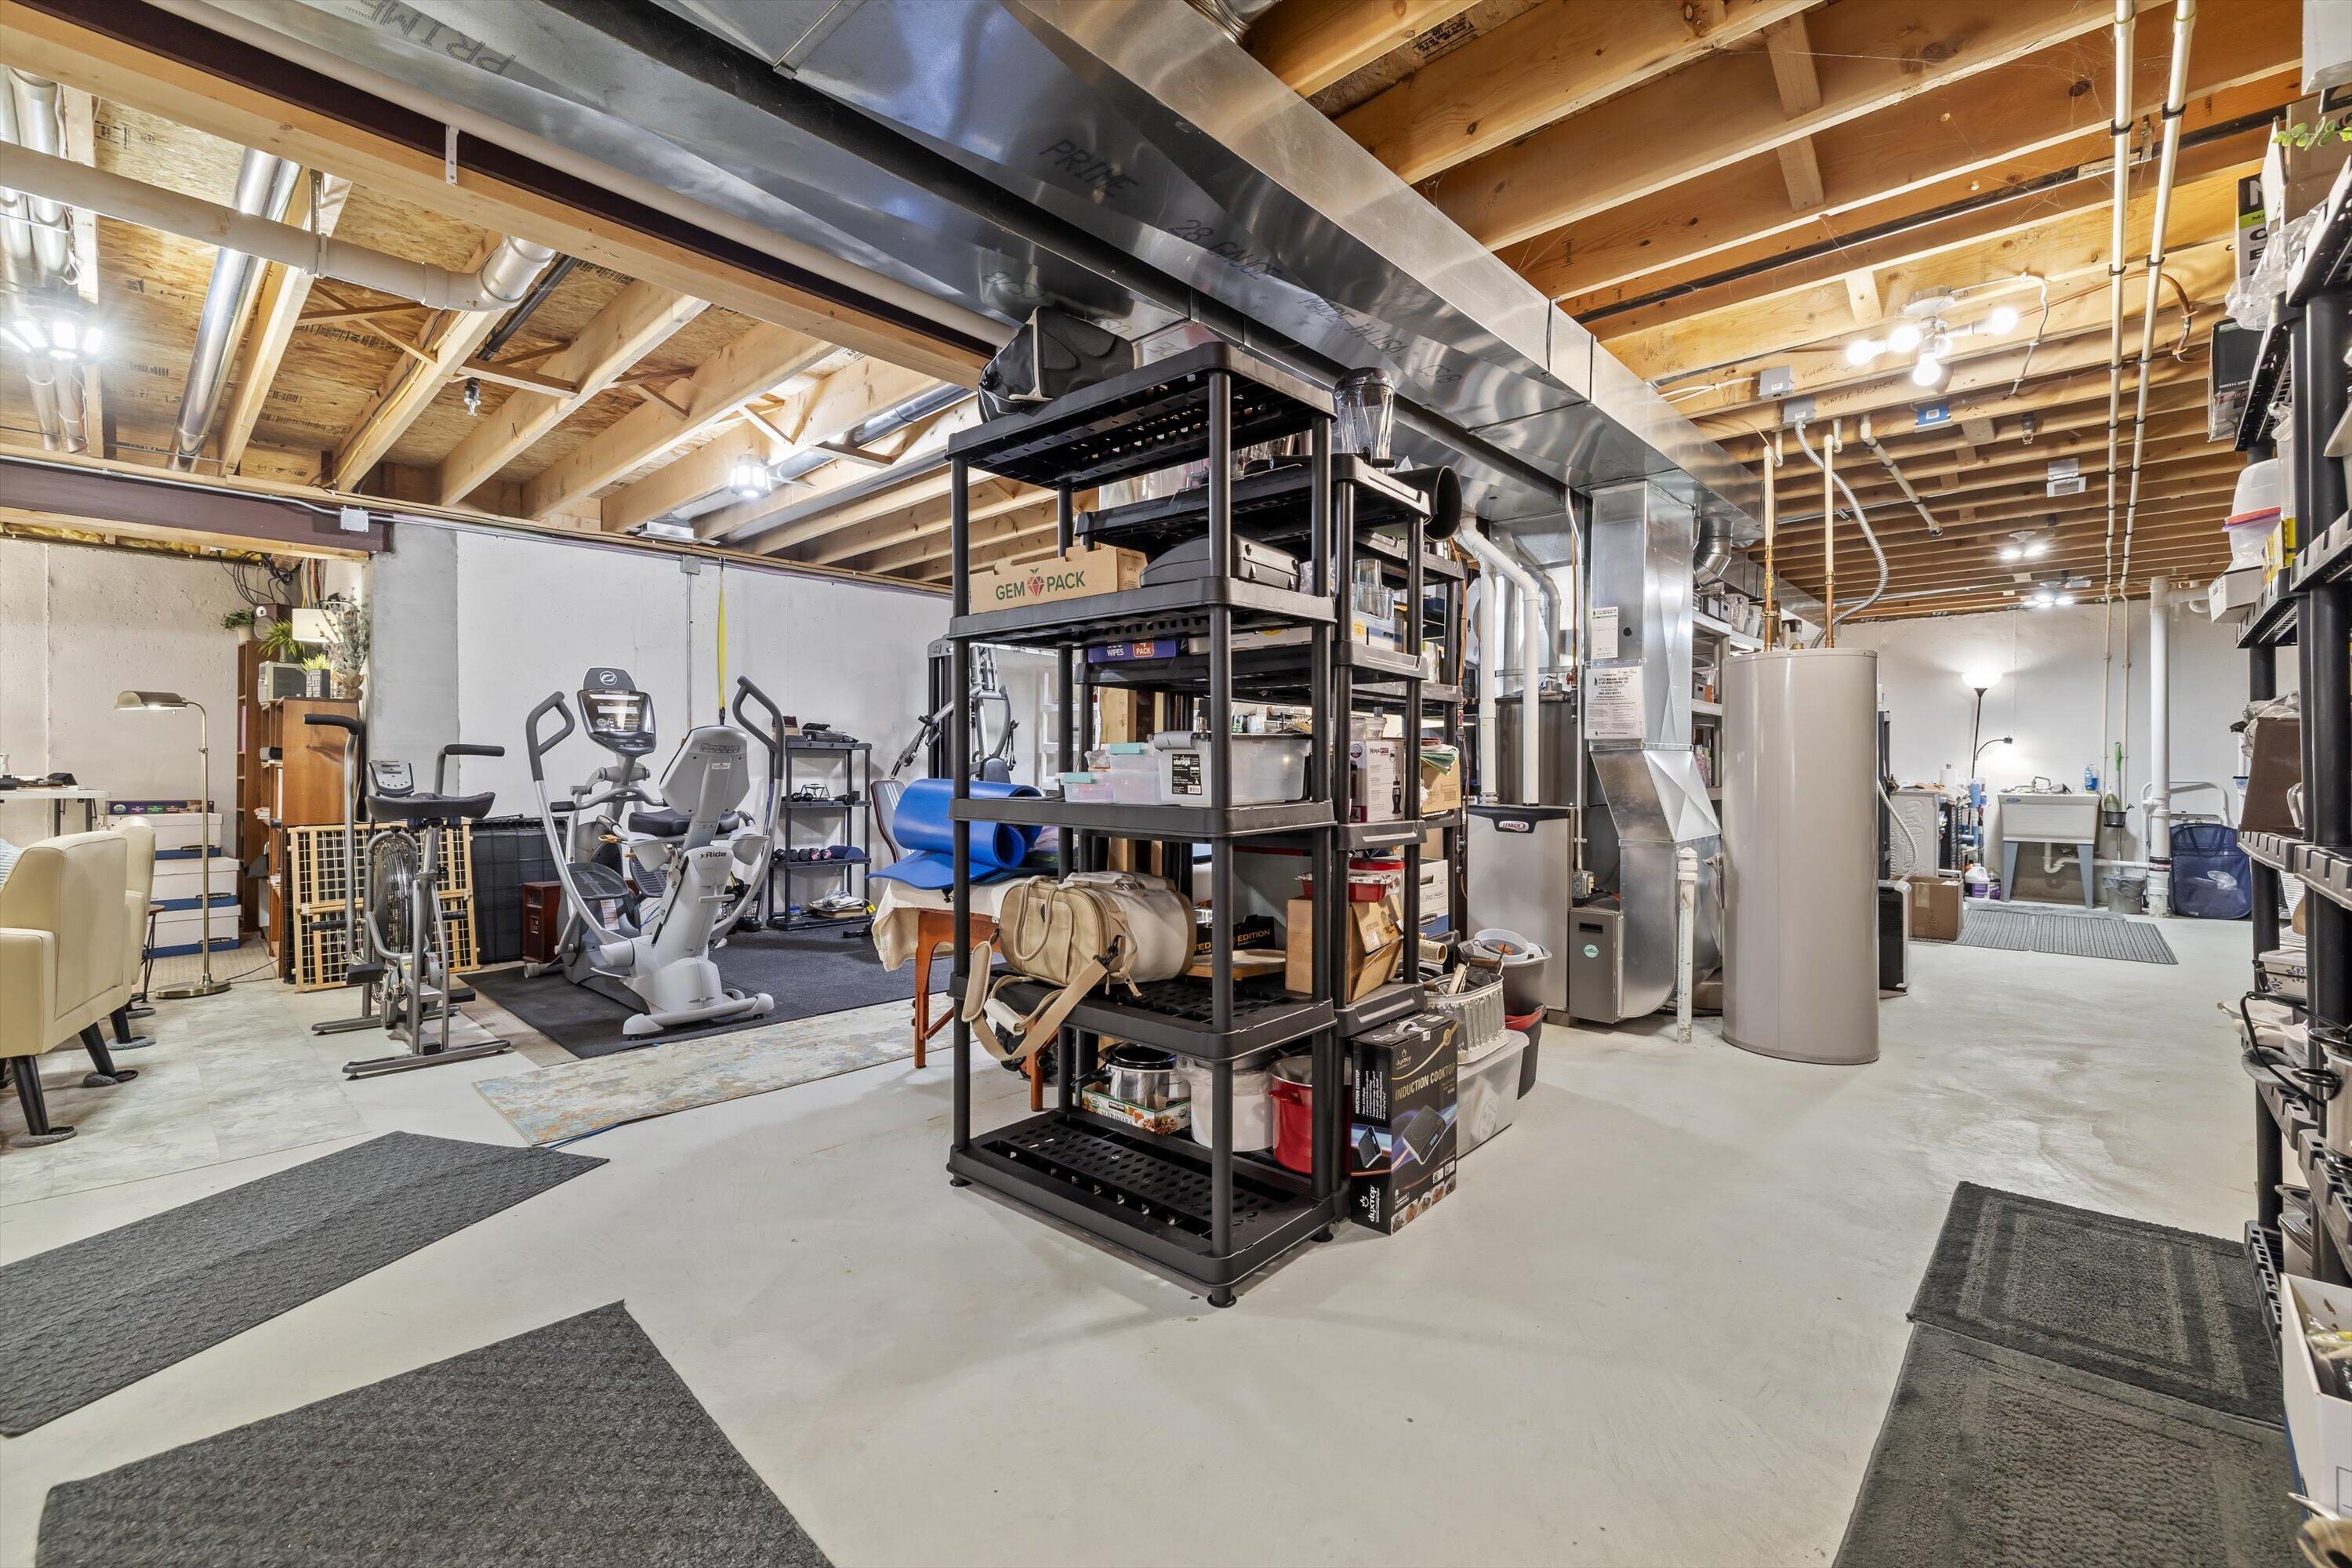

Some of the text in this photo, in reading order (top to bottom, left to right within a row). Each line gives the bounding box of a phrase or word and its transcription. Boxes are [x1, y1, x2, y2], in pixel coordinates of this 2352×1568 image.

[1039, 139, 1139, 196] PRIME
[1167, 220, 1214, 241] 28
[996, 571, 1086, 601] GEM PACK
[1237, 929, 1271, 942] EDITION
[1396, 1076, 1429, 1102] INDUCTION
[1430, 1062, 1456, 1083] COOKTOP
